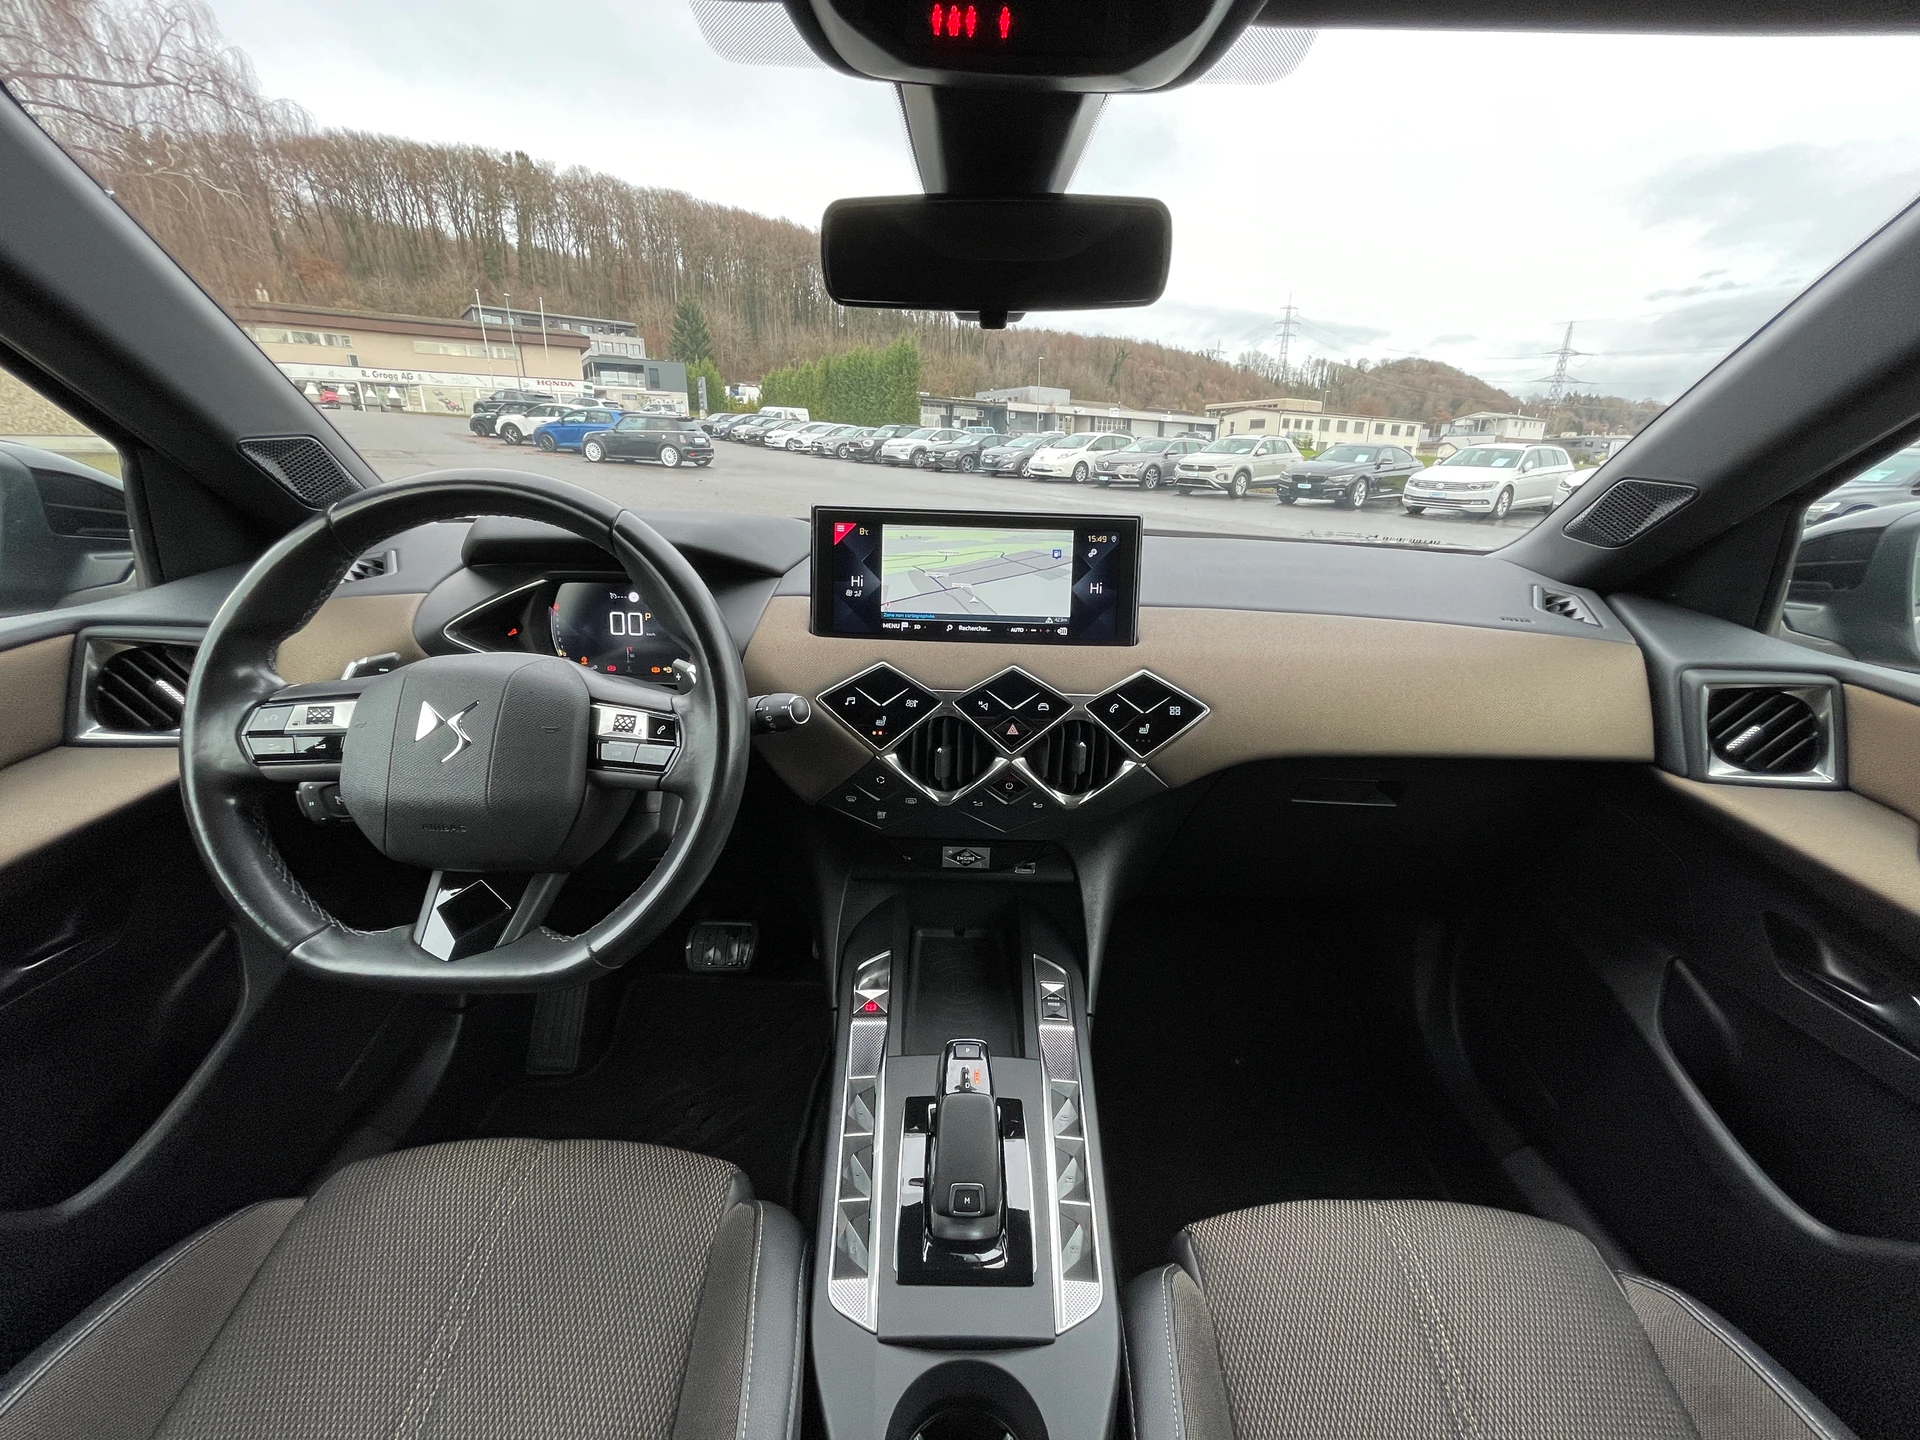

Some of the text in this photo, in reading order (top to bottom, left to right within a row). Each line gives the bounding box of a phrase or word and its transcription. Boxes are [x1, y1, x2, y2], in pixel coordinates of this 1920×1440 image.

[361, 369, 414, 381] R. Grogg AG
[536, 379, 575, 388] HONDA
[1087, 535, 1108, 543] 15:49
[850, 574, 864, 587] Hi
[1089, 581, 1103, 594] Hi
[644, 612, 652, 621] P
[964, 1196, 971, 1204] M
